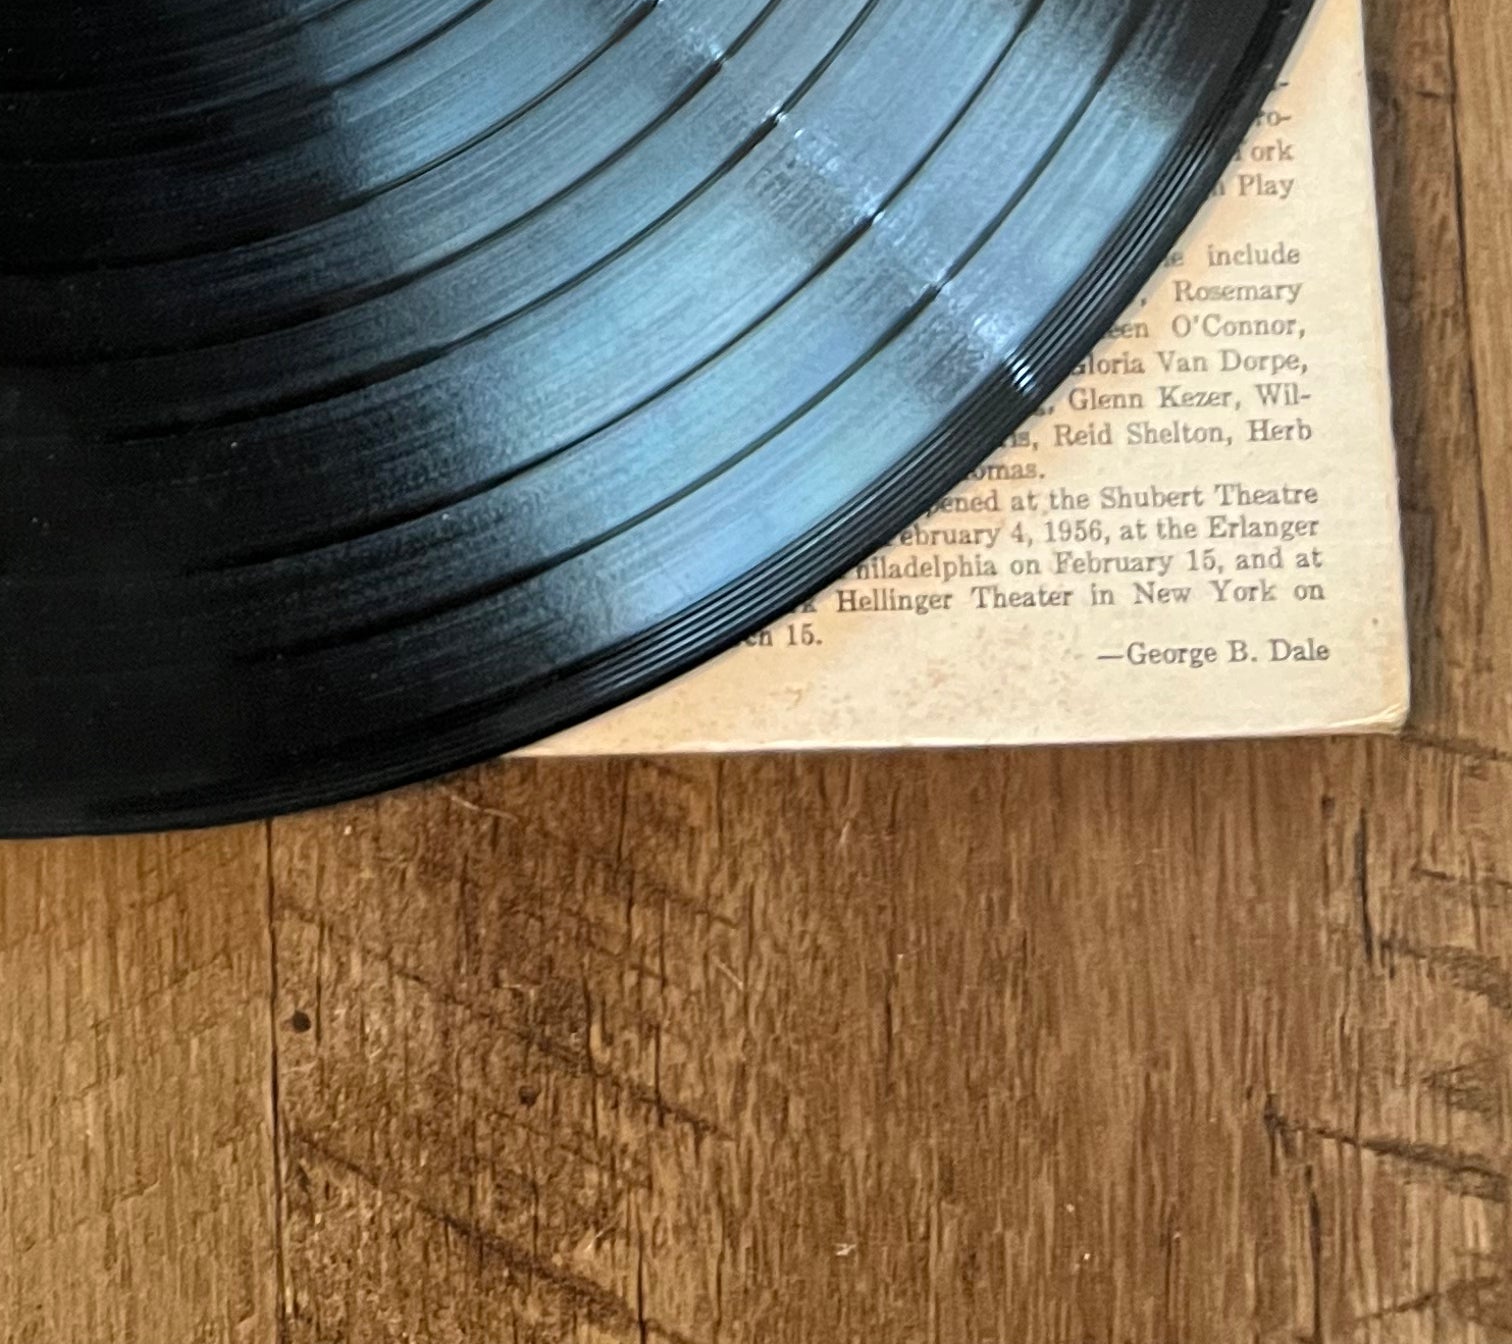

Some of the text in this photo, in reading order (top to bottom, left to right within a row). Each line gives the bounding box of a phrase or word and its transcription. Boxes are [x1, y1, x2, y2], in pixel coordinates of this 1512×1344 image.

[1233, 169, 1295, 201] Play
[1207, 240, 1301, 268] include
[1172, 279, 1303, 306] Rosemary
[1171, 313, 1306, 340] O'Connor,
[1155, 348, 1308, 376] Van Dorpe,
[1067, 387, 1145, 411] Glenn
[1157, 384, 1241, 411] Kezer,
[1053, 417, 1312, 447] Reid Shelton, Herb
[1011, 482, 1319, 512] at the Shubert Theatre
[835, 578, 1326, 616] Hellinger Theater in New York on
[787, 622, 823, 646] 15.
[1226, 639, 1258, 663] B.
[1267, 637, 1330, 662] Dale
